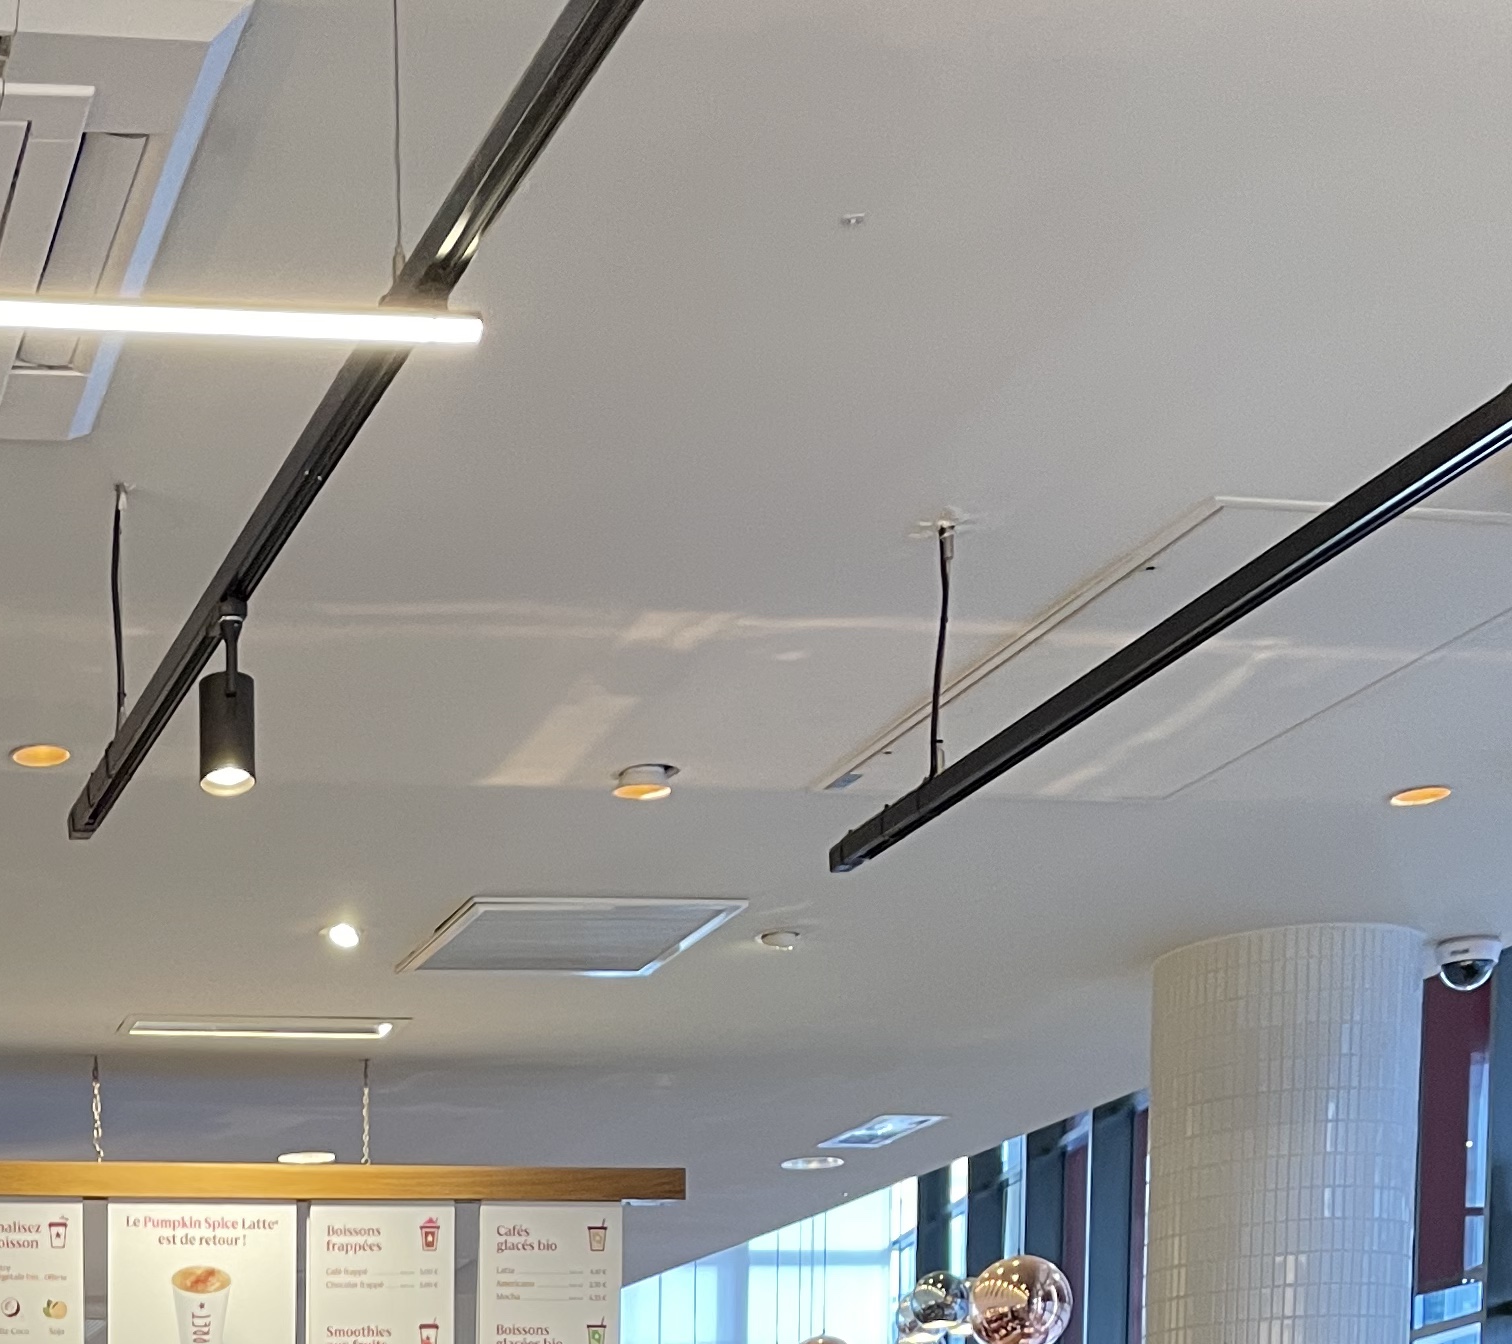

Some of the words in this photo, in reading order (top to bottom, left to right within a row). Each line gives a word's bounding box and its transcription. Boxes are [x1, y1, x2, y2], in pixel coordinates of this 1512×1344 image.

[126, 1216, 141, 1227] Le
[144, 1216, 202, 1231] Pumpkin
[204, 1217, 239, 1232] Spice
[496, 1225, 530, 1236] Cafés
[326, 1225, 382, 1237] Boissons
[158, 1233, 177, 1245] est
[180, 1233, 196, 1245] de
[199, 1234, 240, 1246] retour
[496, 1239, 534, 1253] glacés
[538, 1239, 557, 1251] bio
[326, 1239, 383, 1255] frappées
[191, 1311, 212, 1344] PRET
[326, 1325, 392, 1337] Smoothies
[496, 1324, 550, 1335] Boissons
